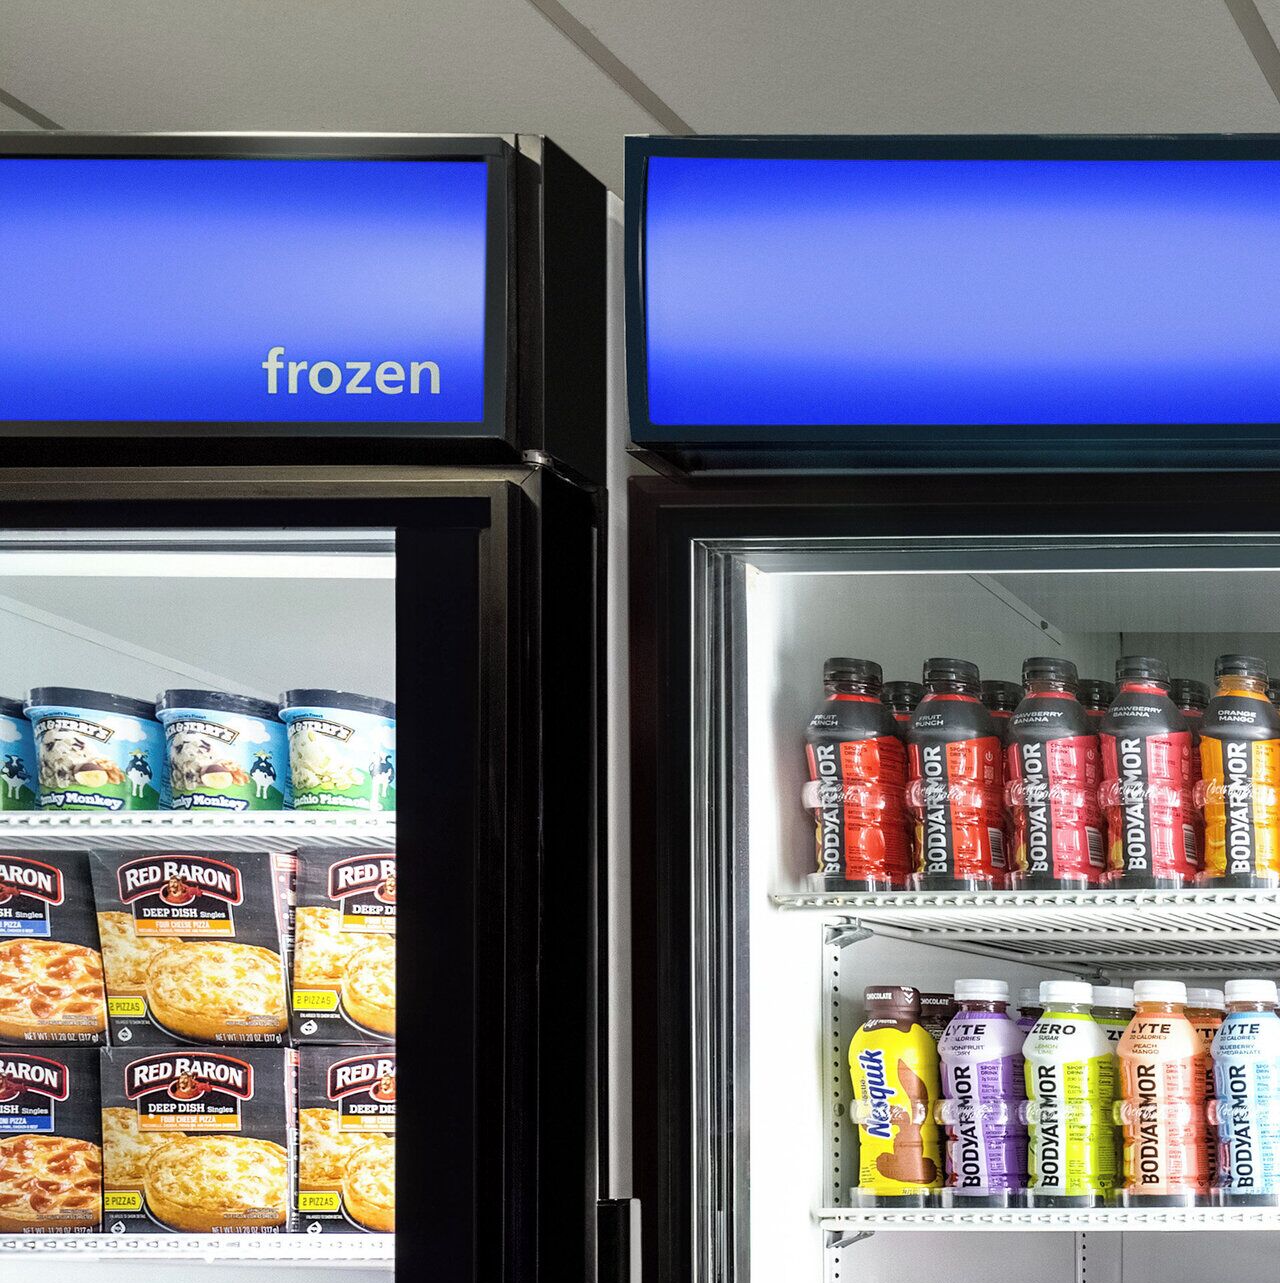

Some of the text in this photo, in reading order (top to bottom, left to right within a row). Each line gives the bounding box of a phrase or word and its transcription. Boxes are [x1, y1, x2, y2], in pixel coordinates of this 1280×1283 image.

[262, 347, 440, 394] frozen
[65, 793, 122, 809] Monkey
[126, 862, 232, 892] RED BARON
[339, 867, 374, 888] RED
[143, 908, 226, 919] DEEP DISH Singles
[117, 1002, 140, 1011] PIZZAS
[1033, 1025, 1076, 1035] ZERO
[1131, 1023, 1171, 1034] LYTE
[1220, 1023, 1260, 1034] LYTE
[134, 1058, 243, 1087] RED BARON
[148, 1103, 233, 1114] DEEP DISH Singles
